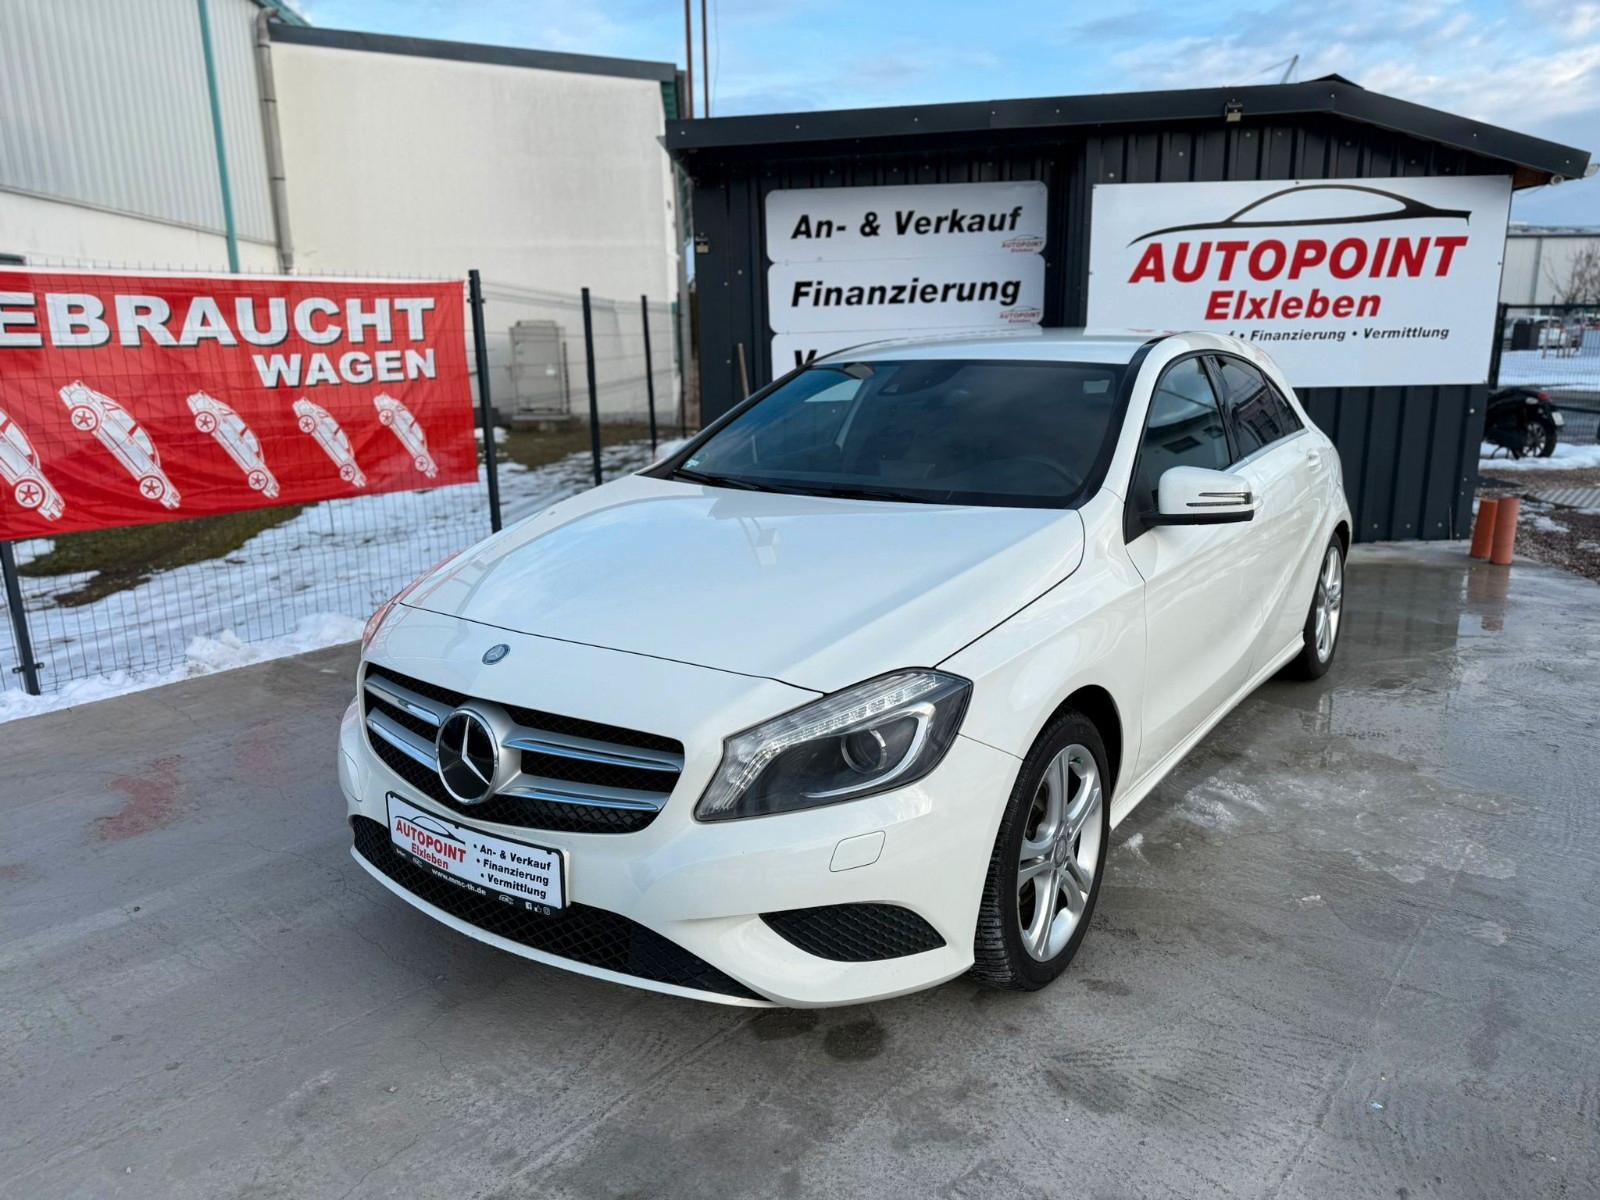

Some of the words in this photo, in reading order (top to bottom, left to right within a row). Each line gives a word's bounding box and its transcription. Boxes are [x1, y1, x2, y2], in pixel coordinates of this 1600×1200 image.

[790, 214, 847, 239] An-
[859, 211, 881, 237] &
[894, 206, 1023, 235] Verkauf
[1127, 236, 1469, 284] AUTOPOINT
[791, 277, 1021, 307] Finanzierung
[1204, 288, 1382, 321] Elxleben
[1249, 328, 1346, 343] Finanzierung
[1362, 326, 1450, 341] Vermittlung
[252, 348, 436, 388] WAGEN
[396, 819, 466, 863] AUTOPOINT
[411, 842, 449, 870] Elxleben
[479, 843, 497, 857] An-
[499, 849, 507, 860] &
[510, 852, 552, 872] Verkauf
[482, 858, 549, 887] Finanzierung
[487, 872, 547, 900] Vermittlung
